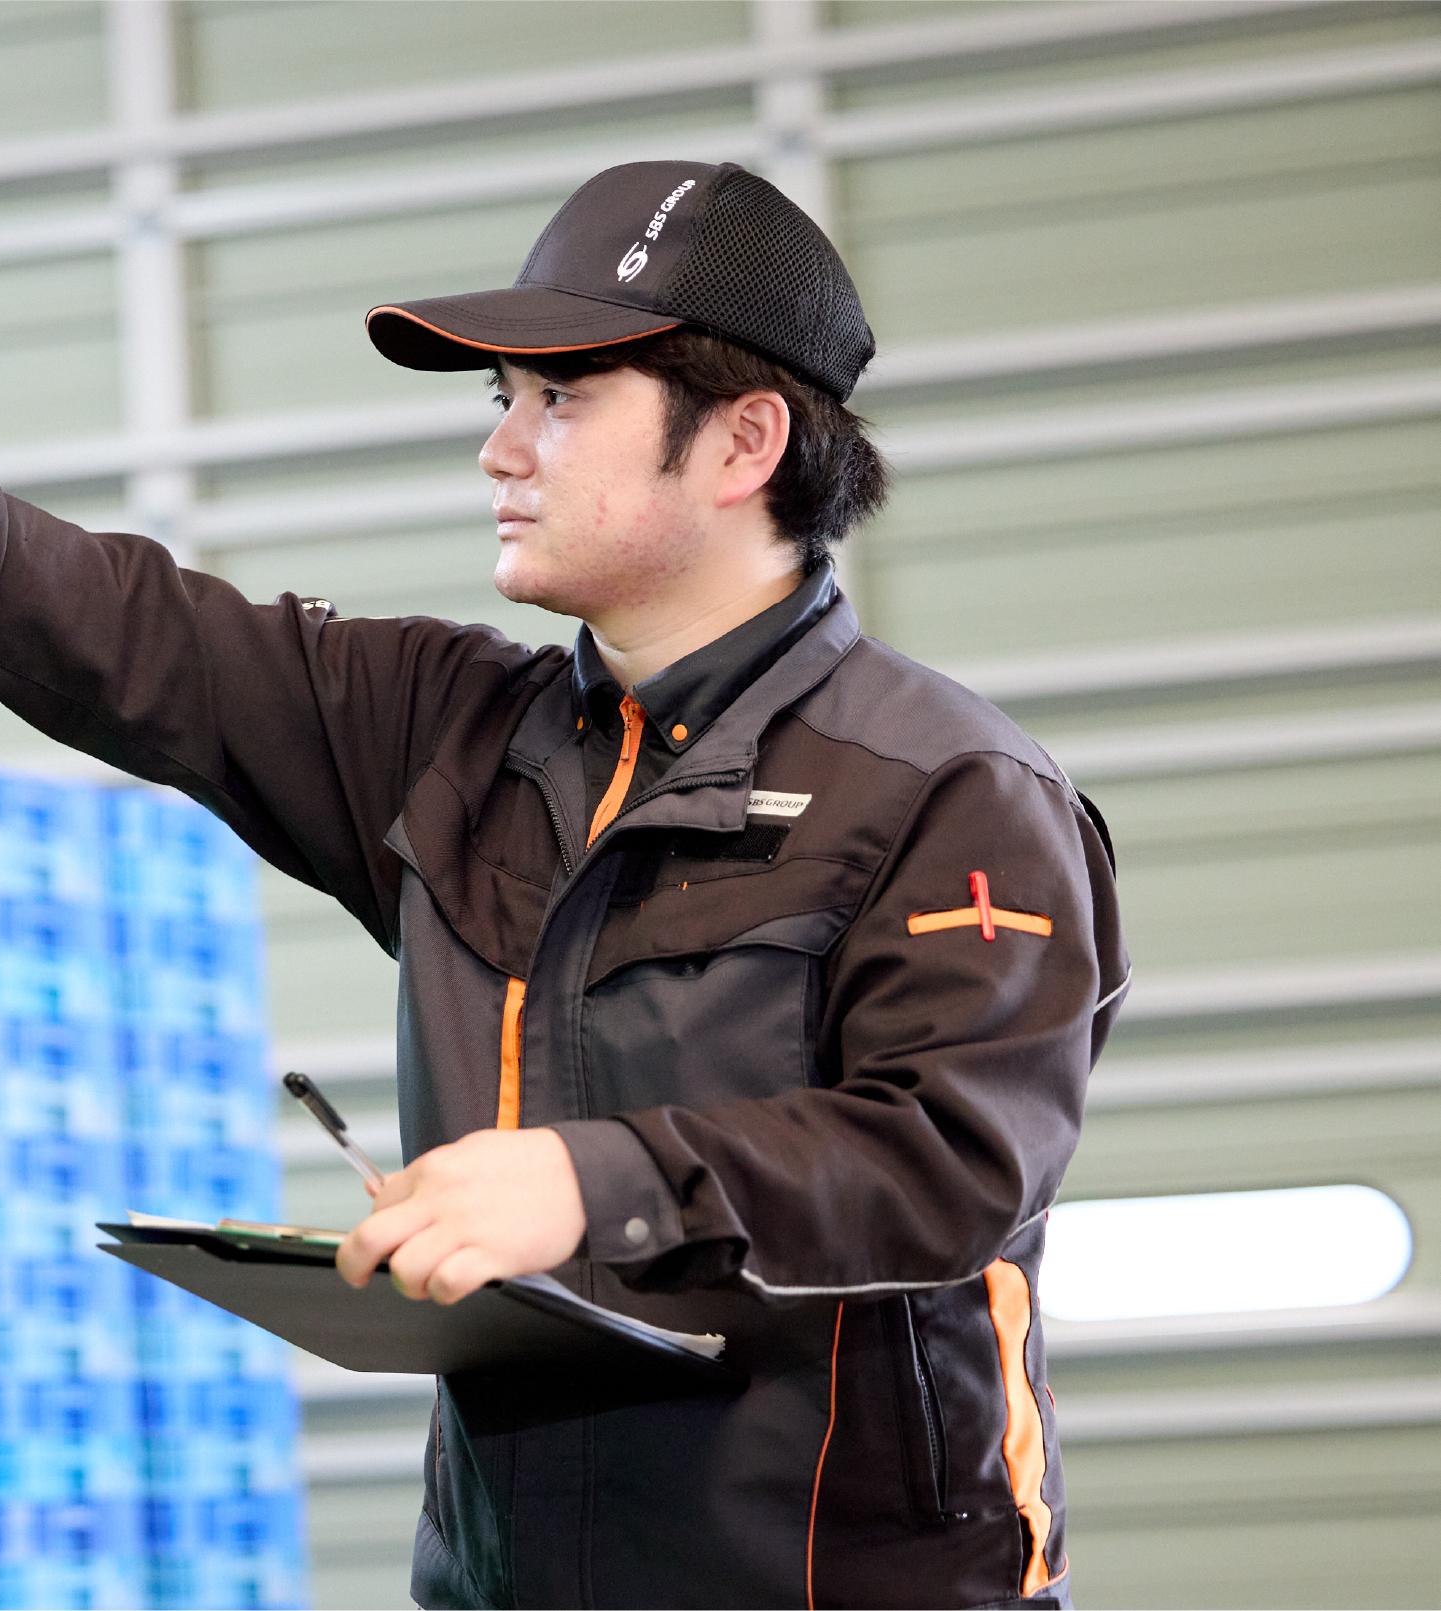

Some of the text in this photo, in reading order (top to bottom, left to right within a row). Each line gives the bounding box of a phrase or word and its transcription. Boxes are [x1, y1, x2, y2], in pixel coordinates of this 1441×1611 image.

[645, 179, 696, 241] SBS GROUP
[748, 797, 804, 809] SBS GROUP
